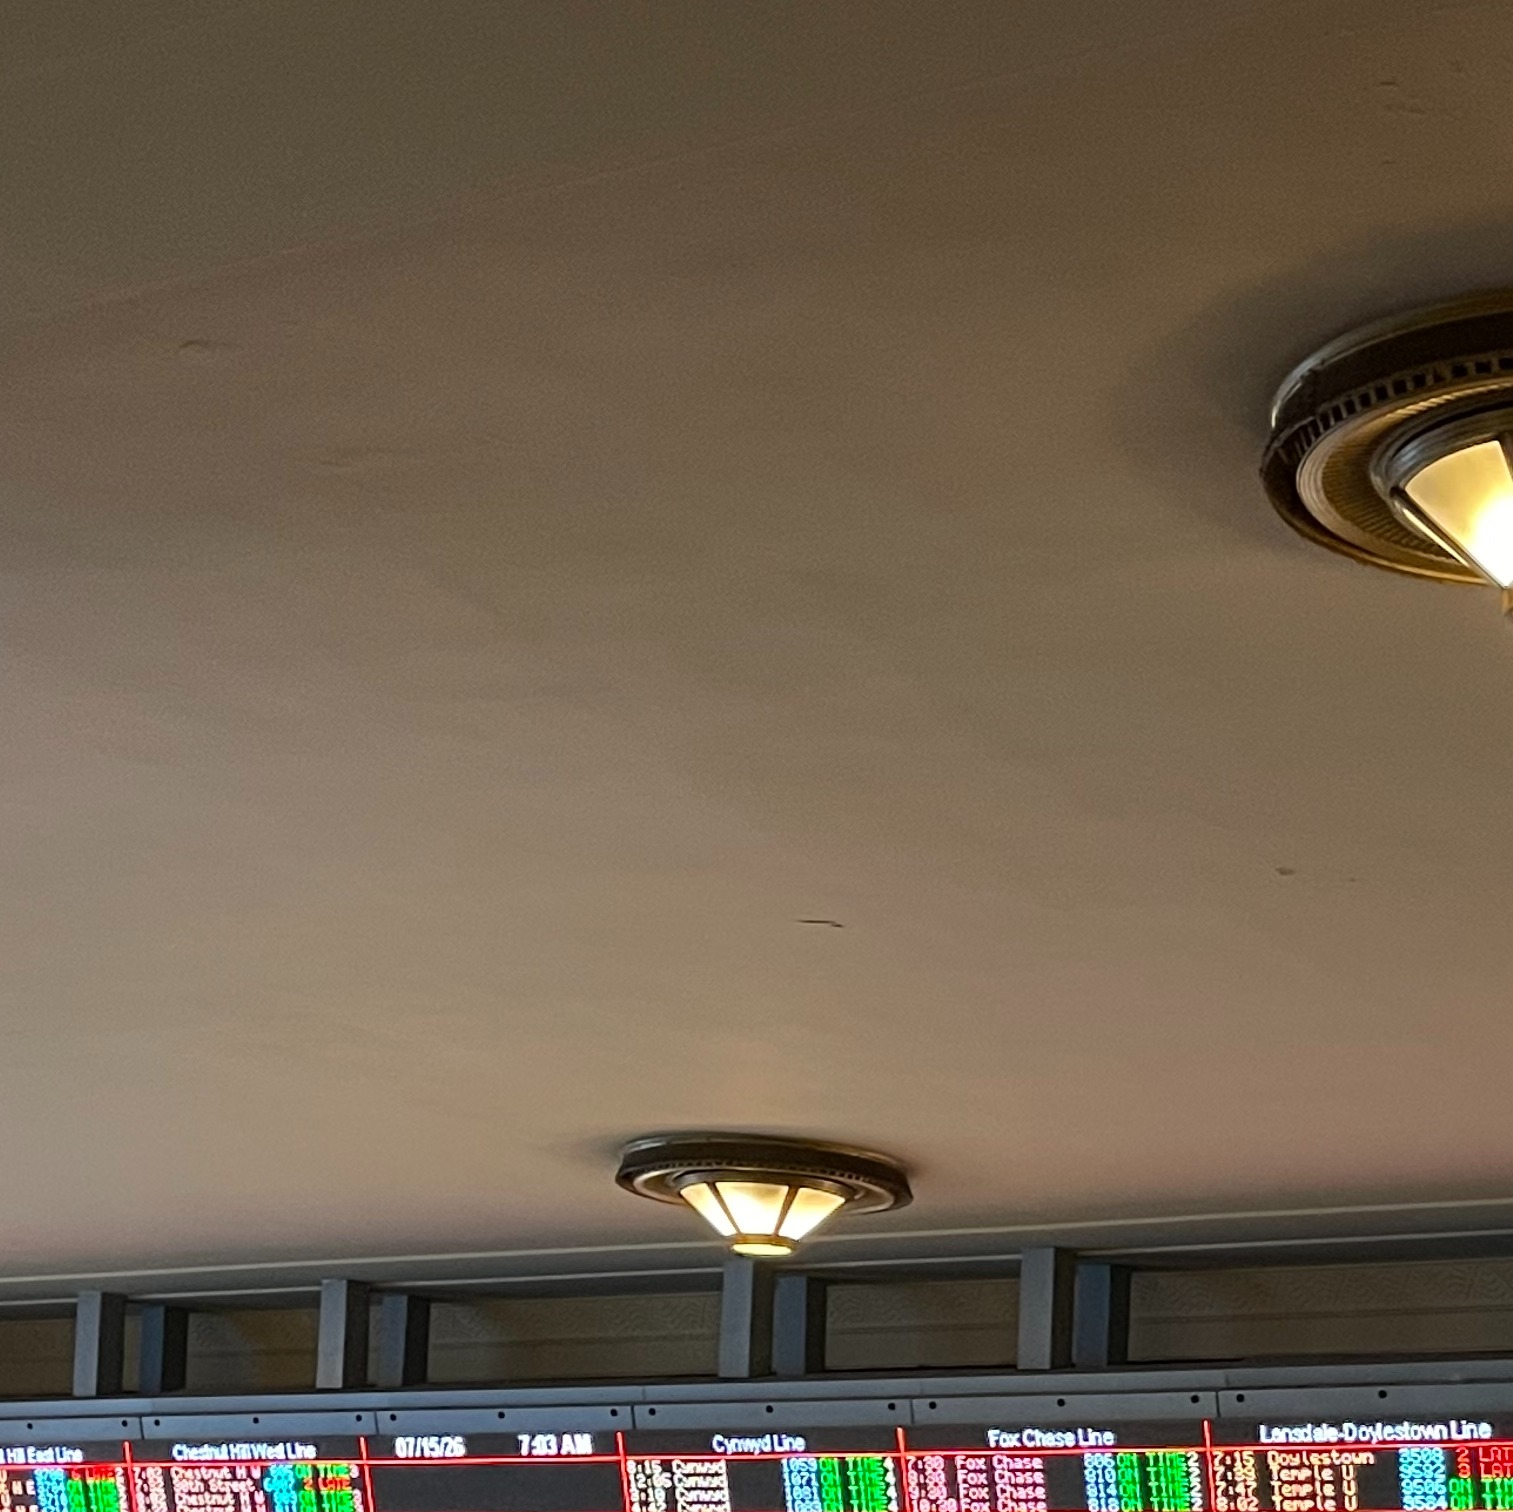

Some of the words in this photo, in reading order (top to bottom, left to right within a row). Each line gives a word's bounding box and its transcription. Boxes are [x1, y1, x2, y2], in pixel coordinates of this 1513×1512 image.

[988, 1430, 1020, 1448] Fox
[1022, 1428, 1075, 1447] Chase
[1078, 1428, 1114, 1446] Line
[1450, 1420, 1492, 1440] Line
[560, 1433, 594, 1455] AM
[773, 1434, 806, 1451] Line
